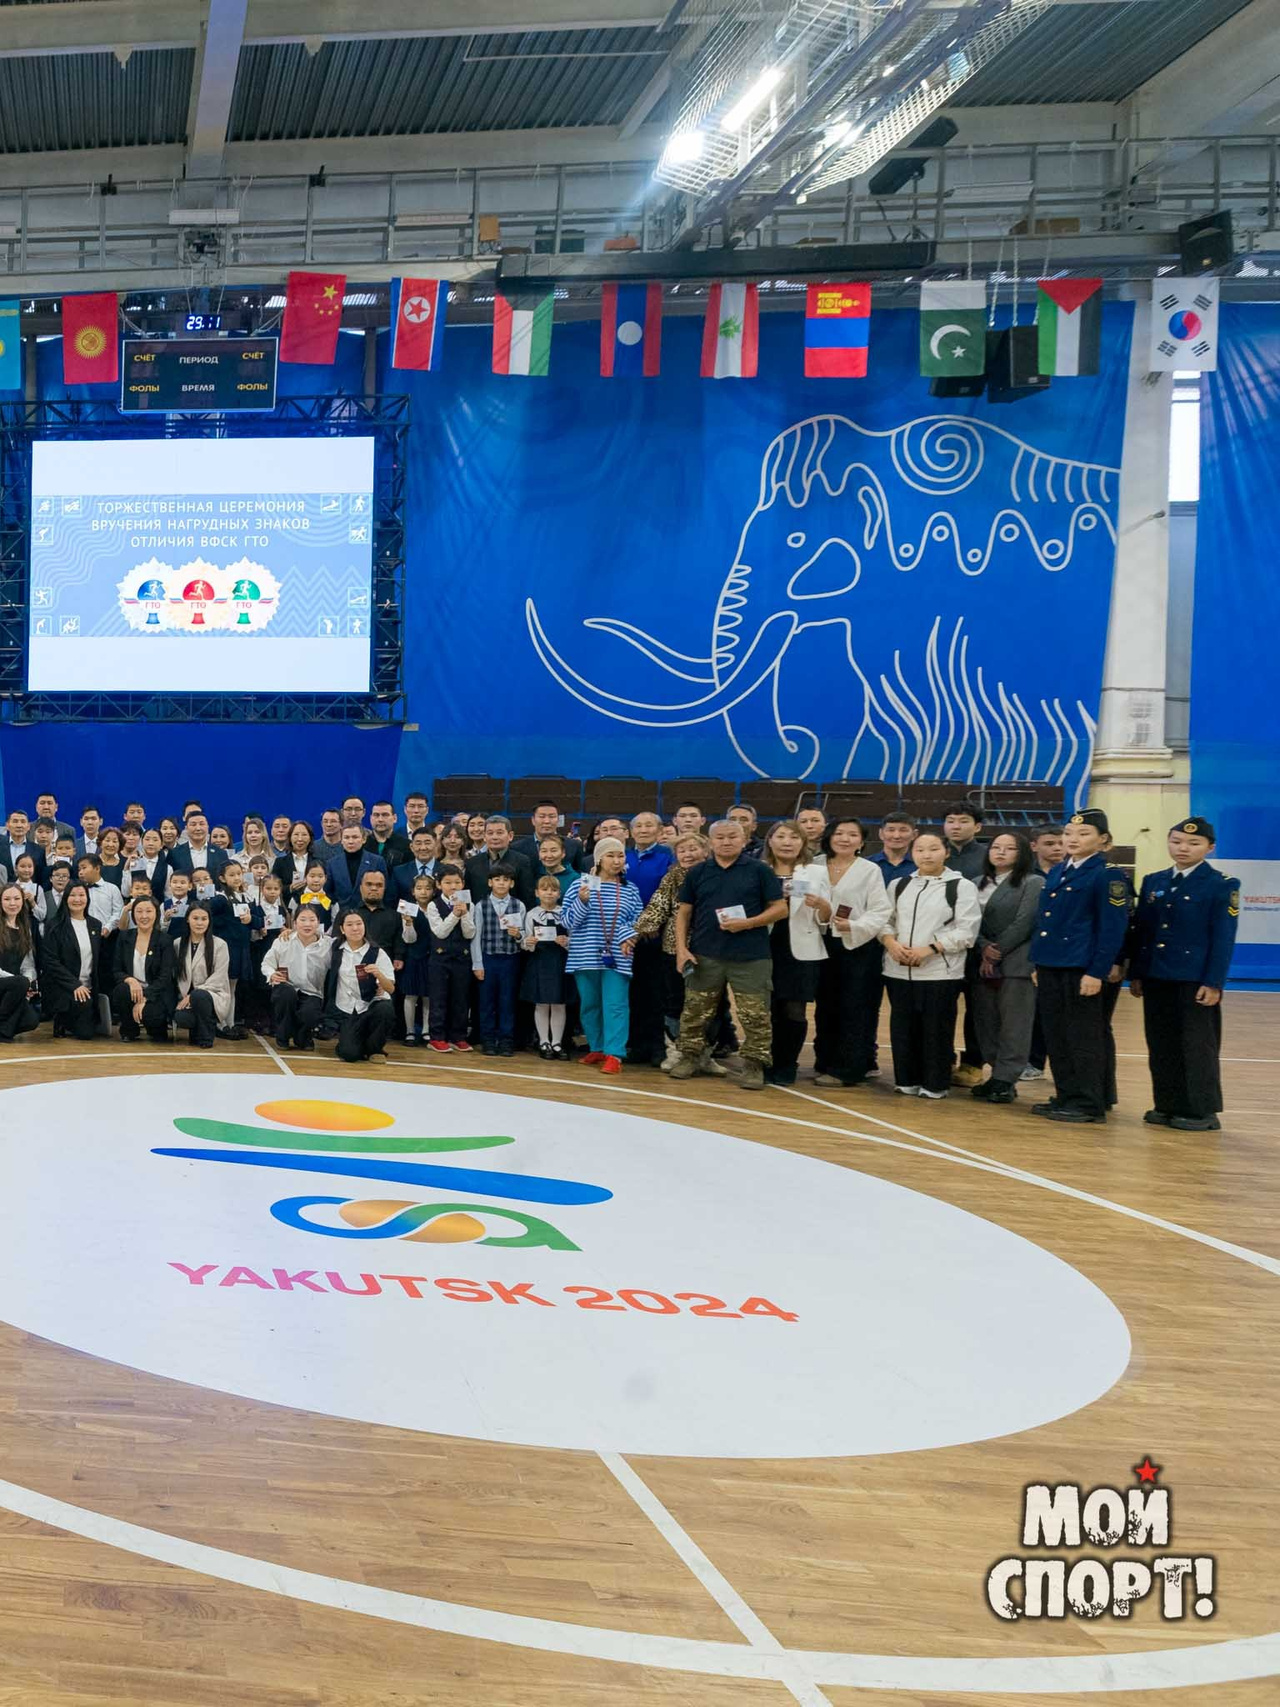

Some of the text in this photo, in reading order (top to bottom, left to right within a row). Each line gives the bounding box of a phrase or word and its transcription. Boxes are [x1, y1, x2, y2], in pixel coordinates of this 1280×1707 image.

[179, 356, 219, 365] ПЕРИОД
[129, 383, 268, 393] ФОЛЫ ВРЕМЯ ФОЛЫ
[97, 500, 306, 515] ТОРЖЕСТВЕННАЯ ЦЕРЕМОНИЯ
[91, 518, 311, 532] ВРУЧЕНИЯ НАГРУДНЫХ ЗНАКОВ
[130, 535, 270, 548] ОТЛИЧИЯ ВФСК ГТО
[144, 601, 161, 609] ГТО
[190, 601, 207, 609] ГТО
[236, 601, 253, 609] ГТО
[166, 1261, 800, 1323] YAKUTSK 2024
